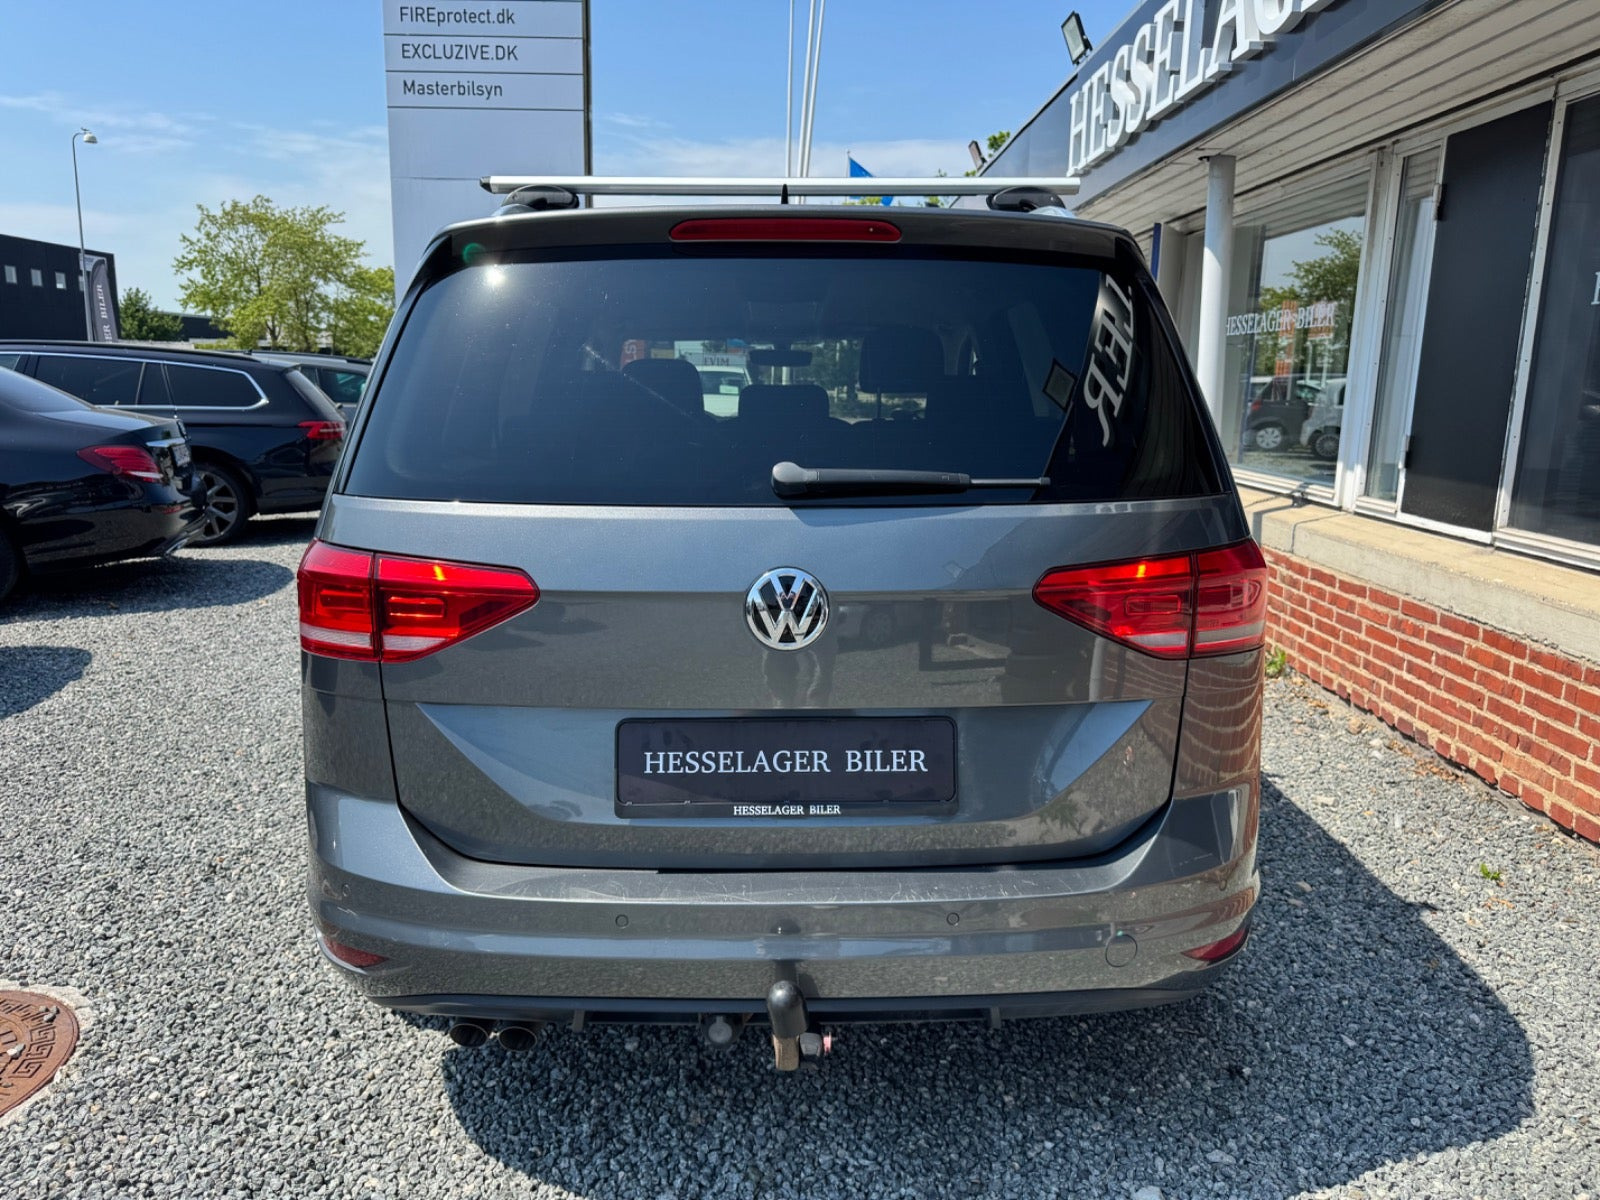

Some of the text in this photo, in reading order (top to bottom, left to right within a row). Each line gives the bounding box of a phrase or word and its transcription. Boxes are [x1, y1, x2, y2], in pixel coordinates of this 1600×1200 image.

[400, 6, 515, 27] FIREprotect.dk
[401, 43, 518, 61] EXCLUZIVE.DK
[403, 79, 503, 100] Masterbilsyn
[1066, 0, 1325, 177] HESSELA
[1296, 302, 1337, 329] BILER
[644, 749, 928, 774] HESSELAGER BILER
[733, 804, 841, 816] HESSELAGER BILER
